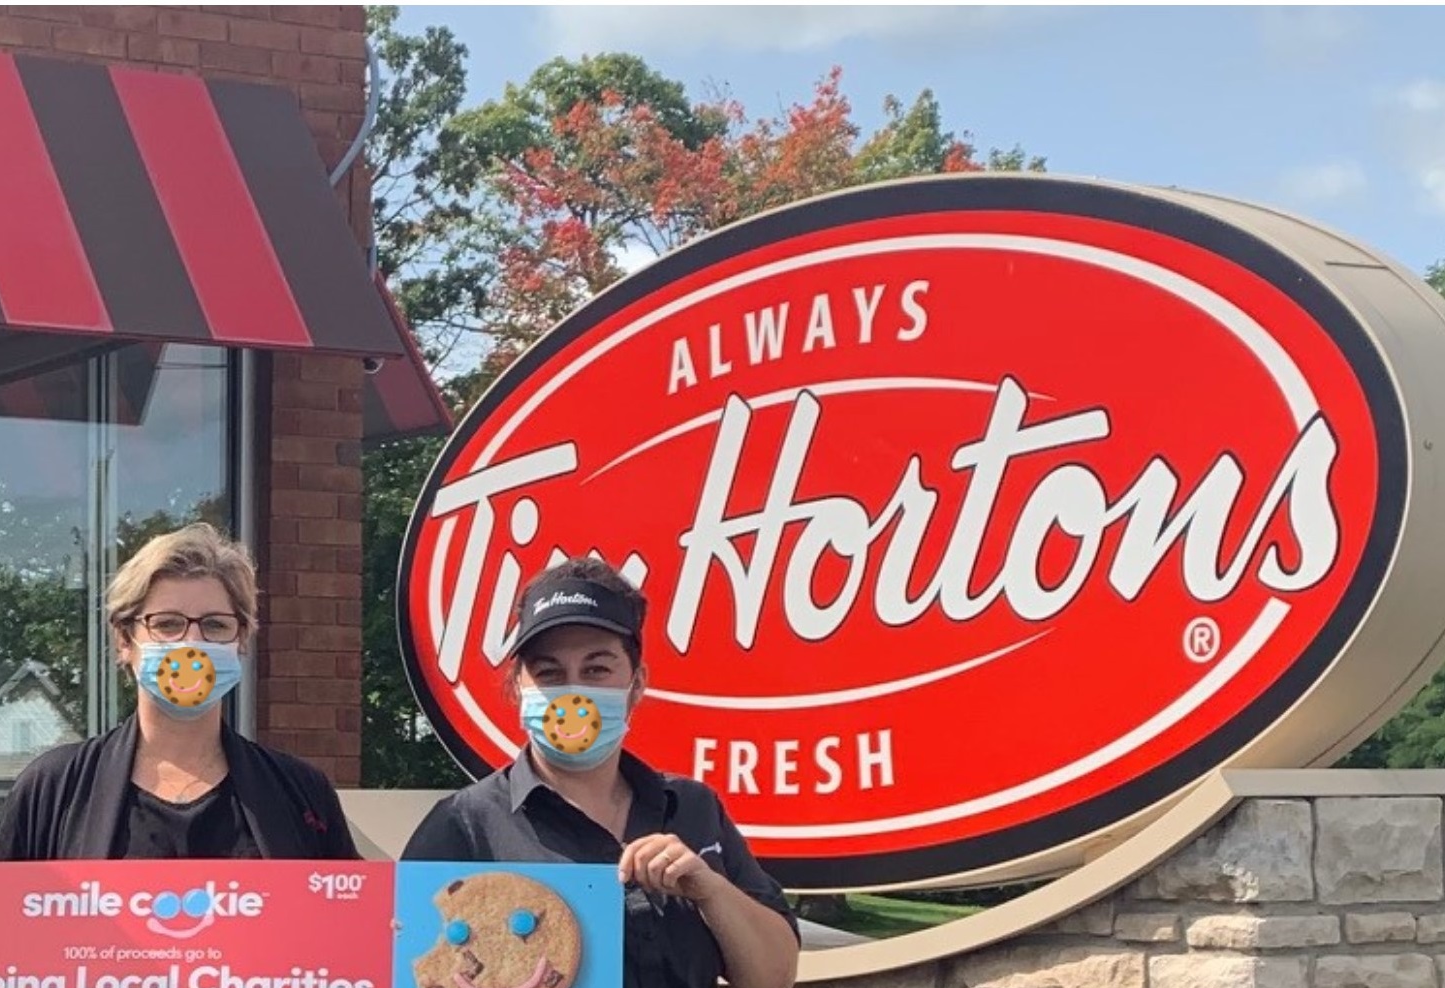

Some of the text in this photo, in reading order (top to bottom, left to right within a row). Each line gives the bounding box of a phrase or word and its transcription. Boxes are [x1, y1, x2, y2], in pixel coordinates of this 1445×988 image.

[667, 279, 930, 396] ALWAYS
[431, 375, 1340, 685] Ti Hortons
[693, 729, 895, 796] FRESH
[22, 879, 264, 920] smile cookie
[63, 945, 222, 965] 100% of proceeds go to
